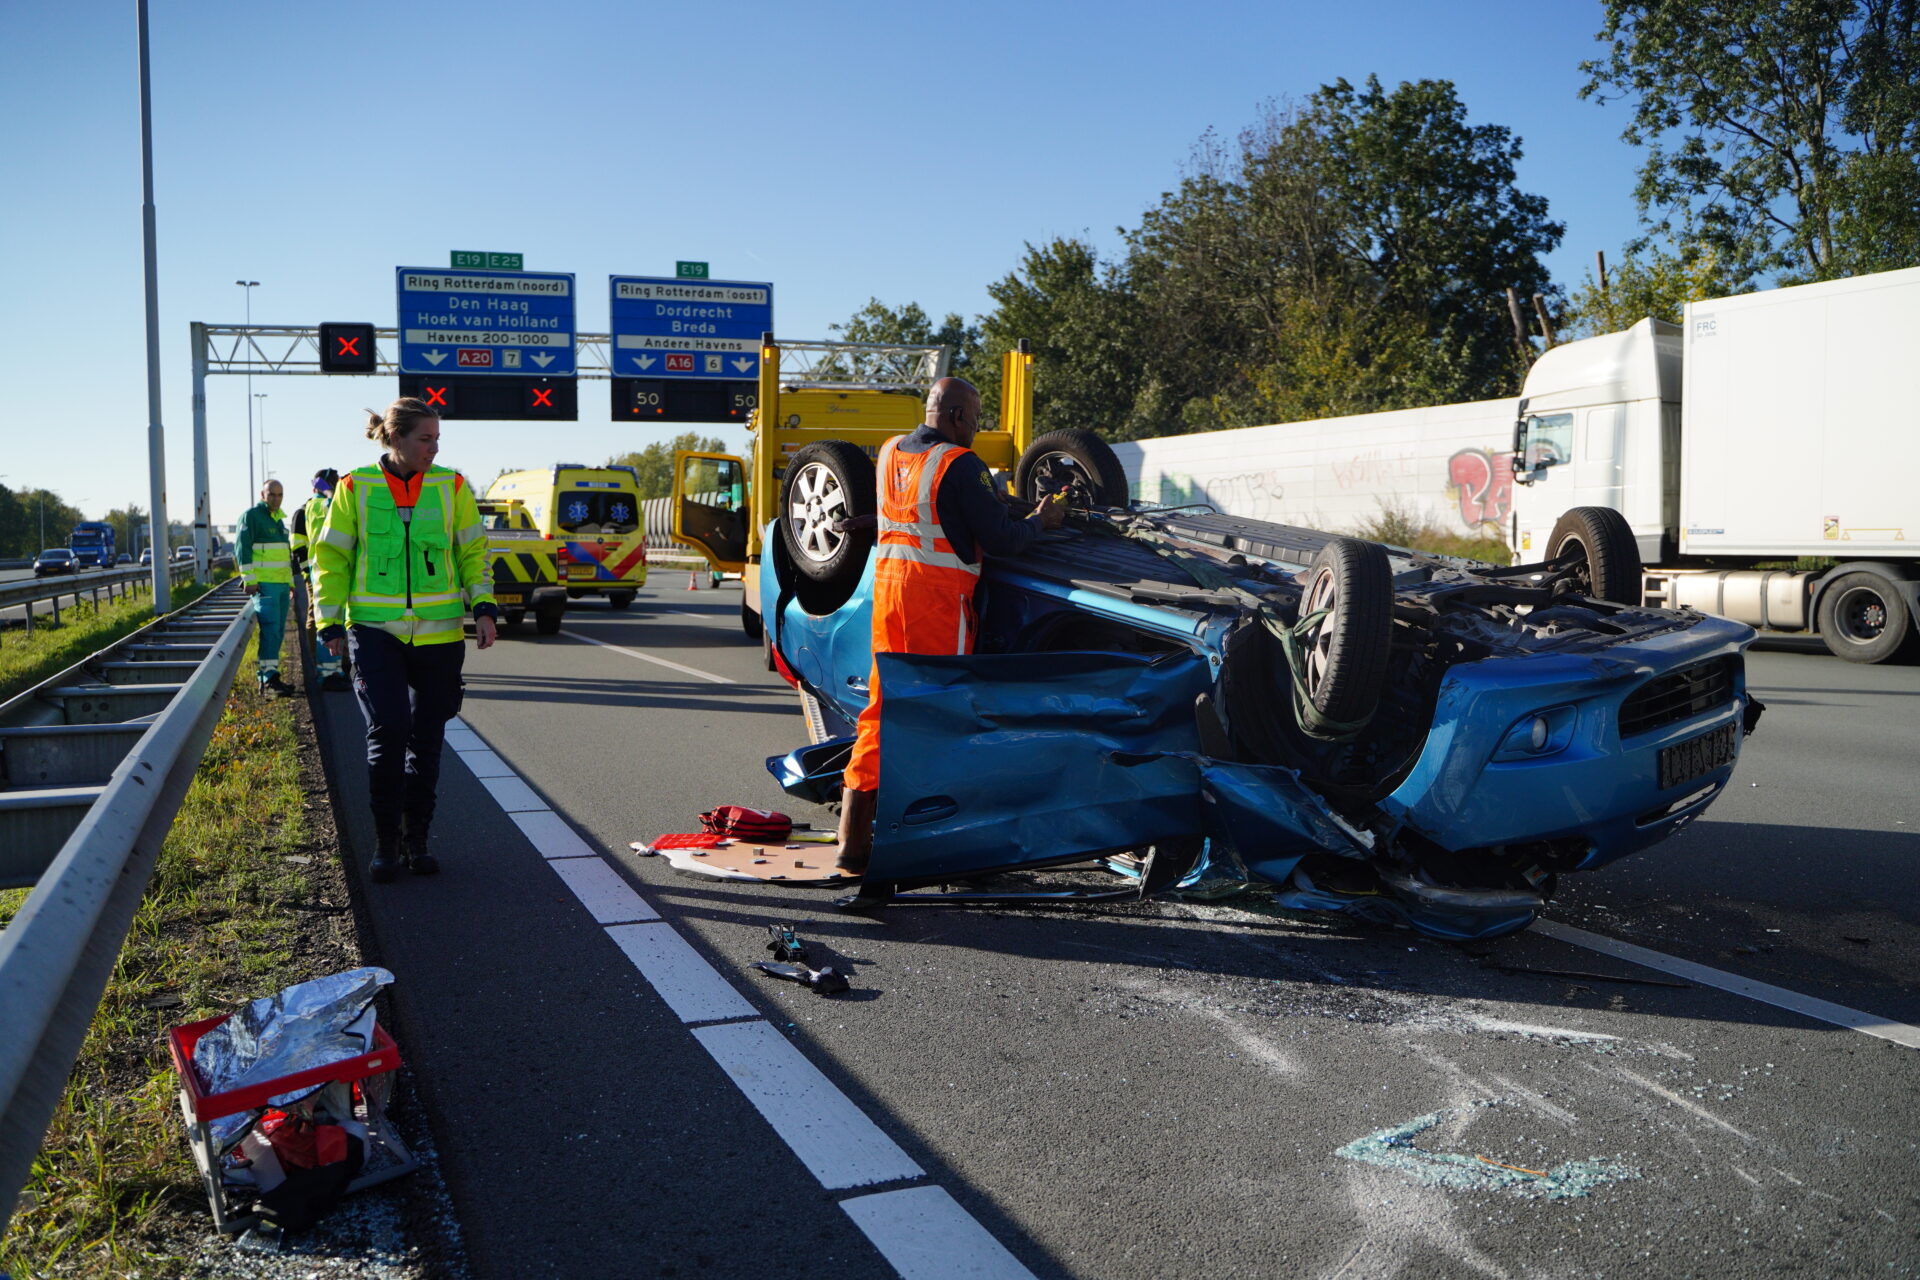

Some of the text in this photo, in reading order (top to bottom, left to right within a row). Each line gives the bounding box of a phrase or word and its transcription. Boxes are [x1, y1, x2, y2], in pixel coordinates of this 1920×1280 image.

[457, 254, 520, 267] E19 E25
[682, 265, 703, 275] E19
[408, 276, 565, 292] Ring Rotterdam (noord)
[621, 284, 764, 300] Ring Rotterdam (oost)
[449, 297, 529, 314] Den Haag
[656, 304, 732, 318] Dordrecht
[418, 312, 558, 328] Hoek van Holland
[1696, 320, 1717, 332] FRC
[672, 321, 716, 334] Breda
[427, 332, 549, 345] Havens 200-1000
[644, 338, 742, 351] Andere Havens
[460, 353, 490, 363] A20
[508, 353, 516, 364] 7
[668, 357, 692, 368] A16
[710, 359, 717, 369] 6
[637, 392, 660, 405] 50
[735, 394, 757, 407] 50
